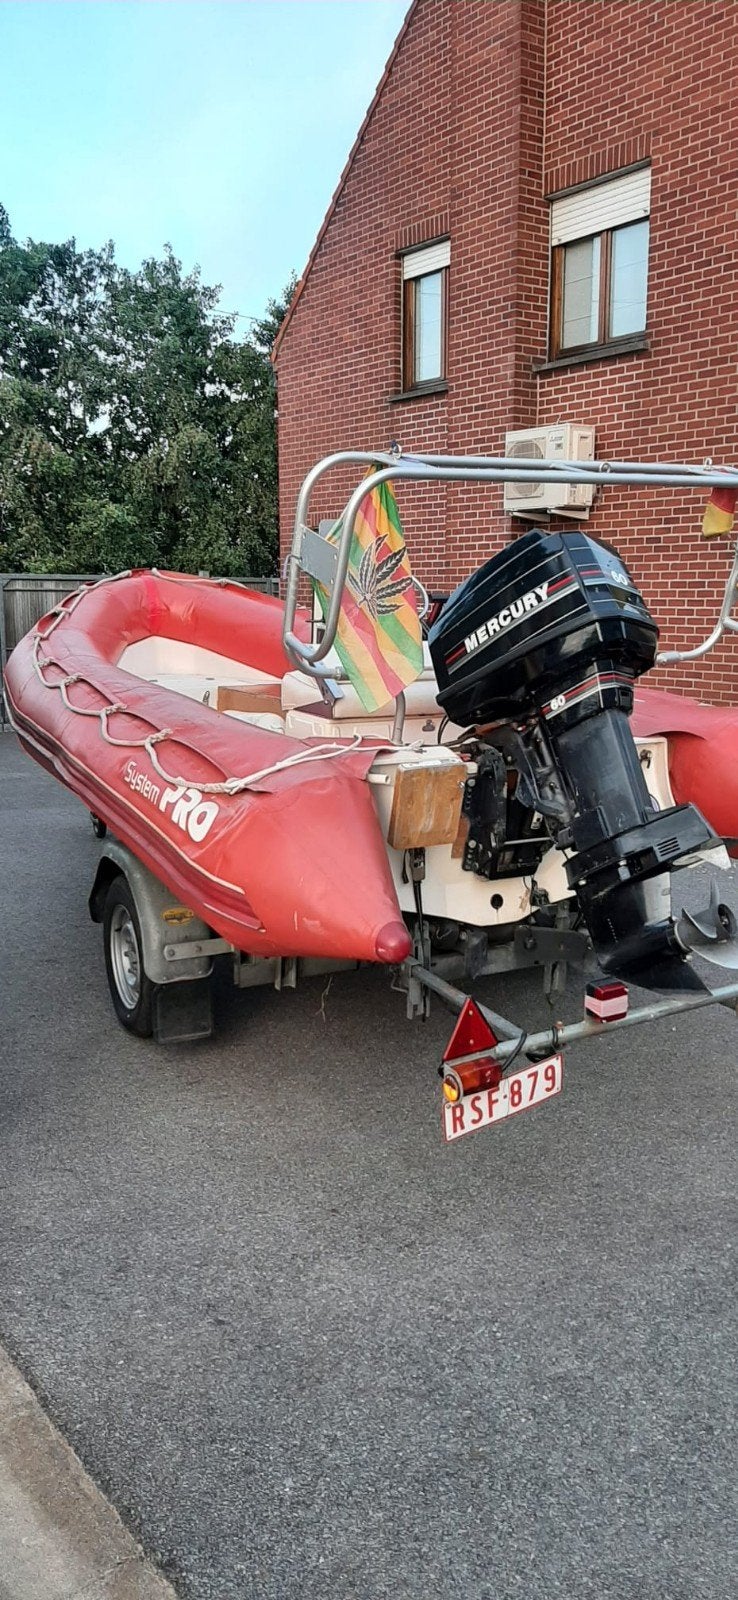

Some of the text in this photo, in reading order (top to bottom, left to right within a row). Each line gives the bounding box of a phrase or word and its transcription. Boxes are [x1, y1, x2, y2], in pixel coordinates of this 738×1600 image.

[611, 570, 628, 586] 60
[464, 583, 549, 653] MERCURY
[550, 694, 565, 710] 60
[124, 761, 219, 843] System PRO
